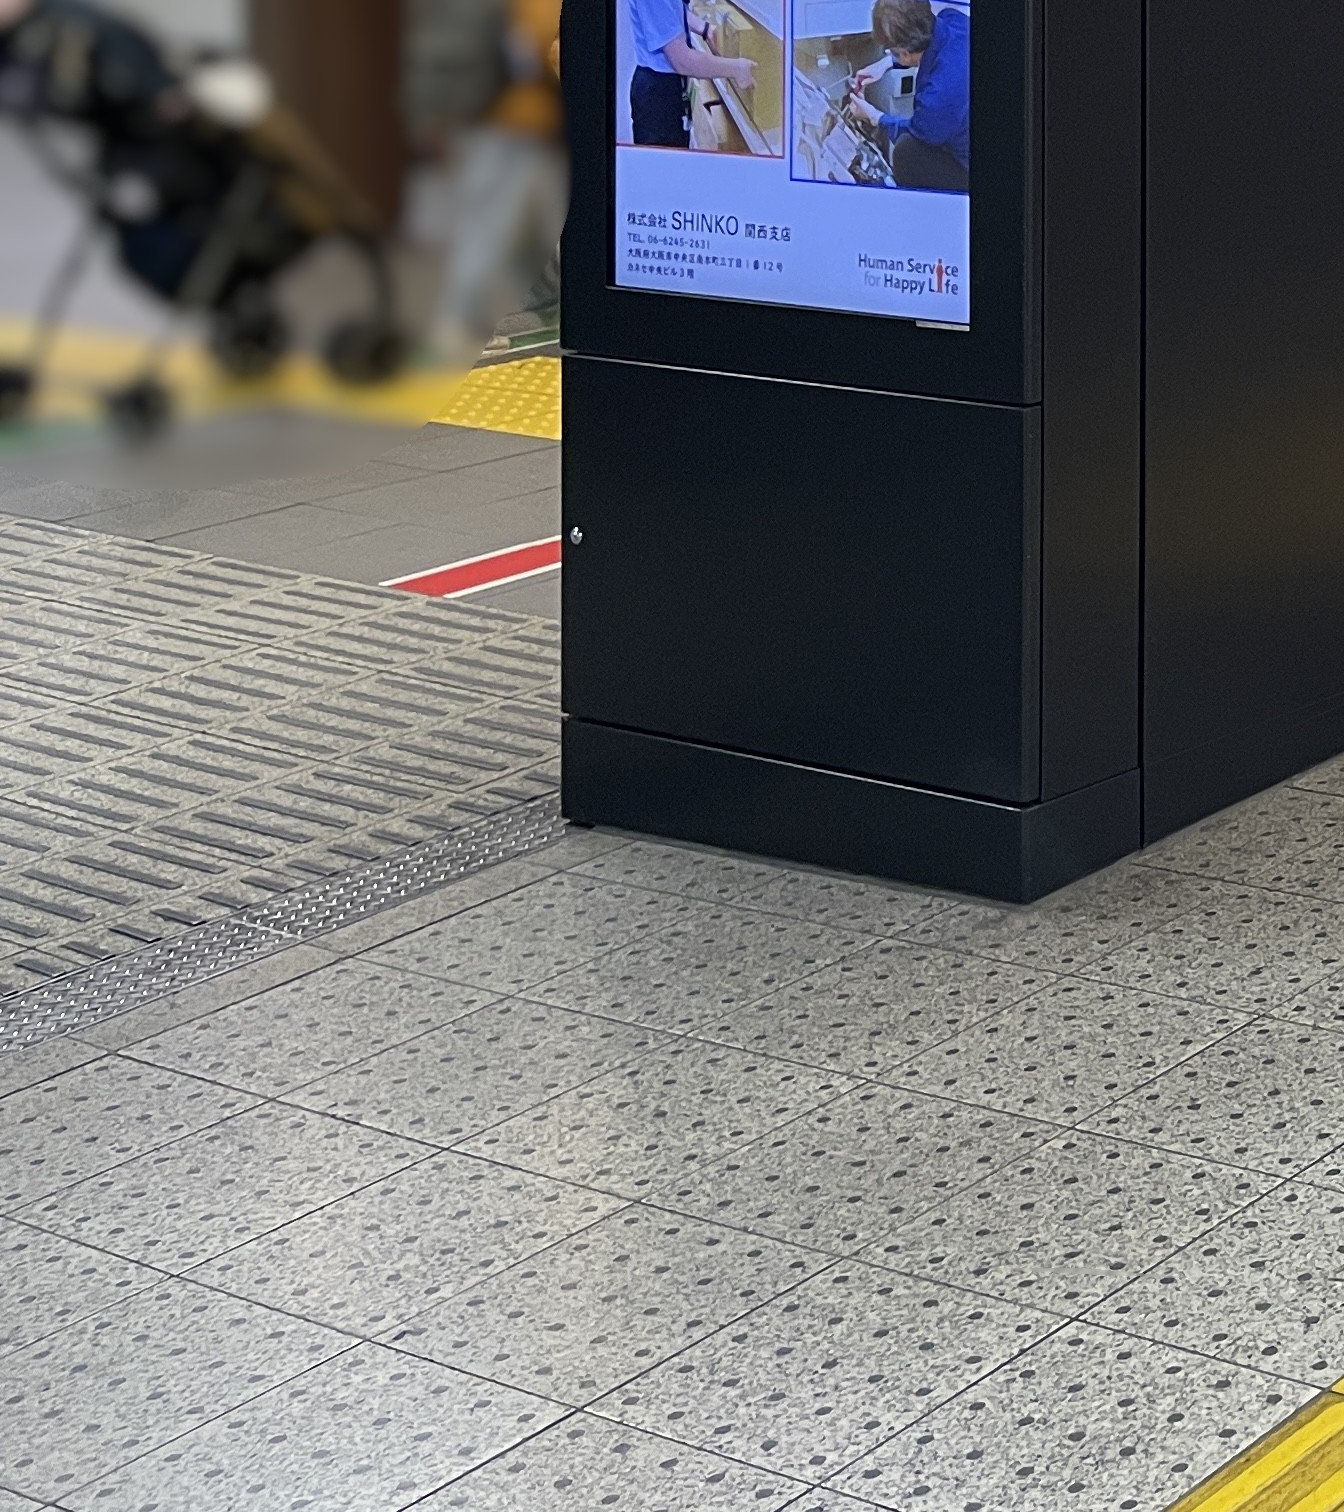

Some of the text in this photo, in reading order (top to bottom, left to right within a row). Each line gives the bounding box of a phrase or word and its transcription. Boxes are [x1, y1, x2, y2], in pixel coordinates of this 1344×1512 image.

[627, 210, 791, 242] 株式会社 SHINKO 関西支店
[858, 253, 959, 277] Human Service
[864, 271, 959, 295] for Happy Life
